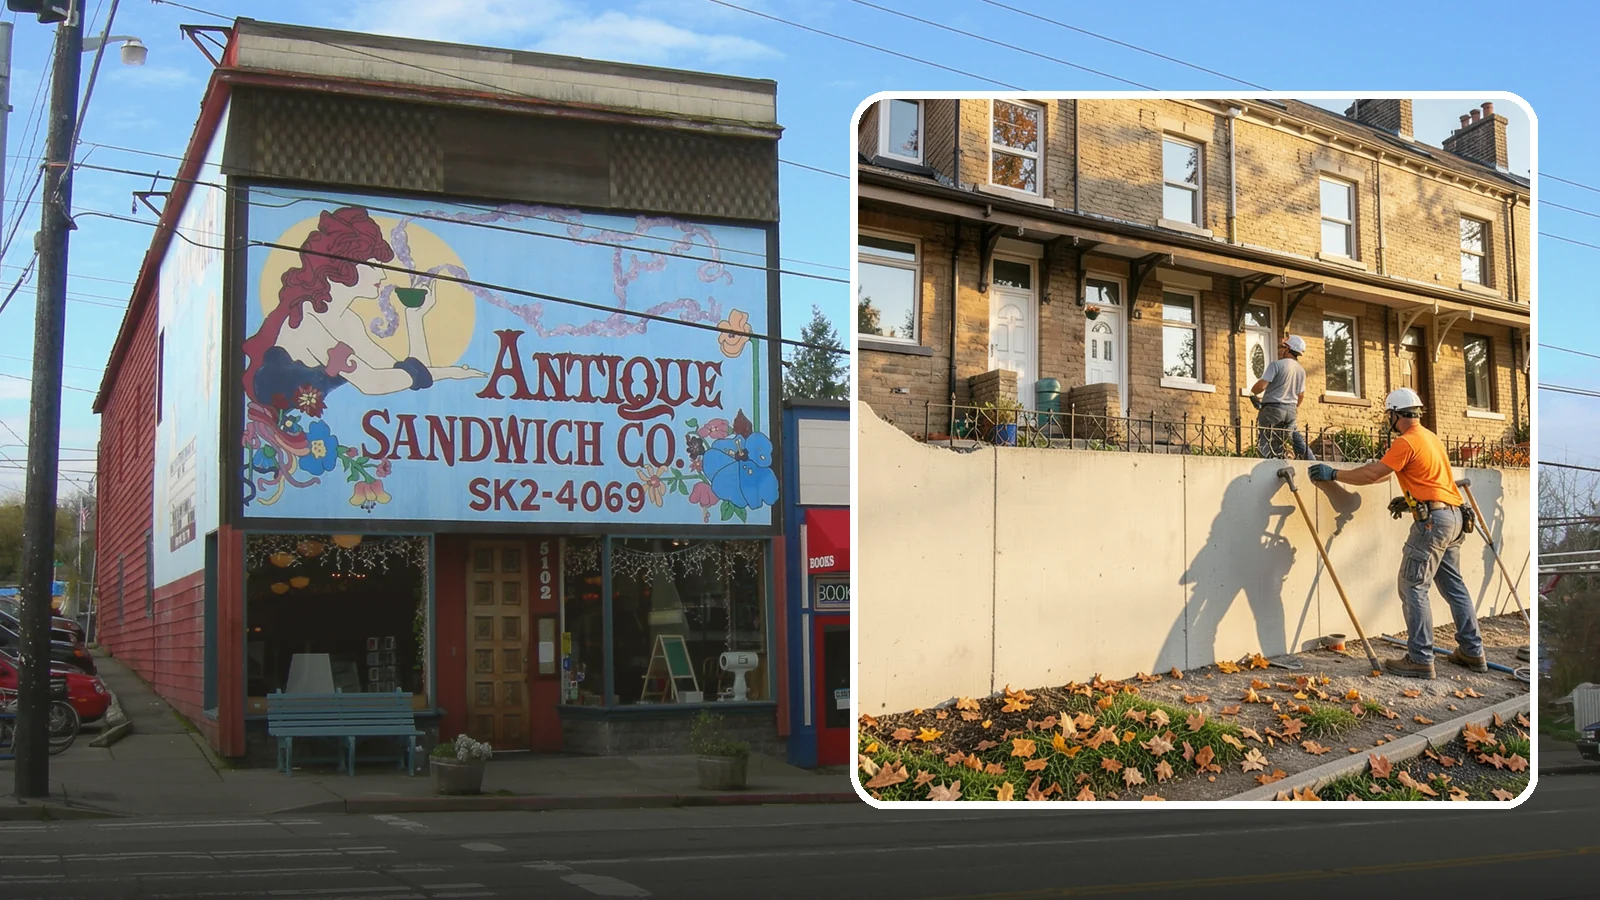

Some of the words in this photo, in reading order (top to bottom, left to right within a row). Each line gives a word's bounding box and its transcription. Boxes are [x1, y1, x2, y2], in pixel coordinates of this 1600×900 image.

[475, 329, 724, 420] ANTIQUE
[361, 408, 604, 467] SANDWICH
[617, 423, 684, 469] CO.
[468, 477, 645, 513] SK2-4069
[540, 541, 551, 599] 5102
[809, 554, 835, 569] BOOKS
